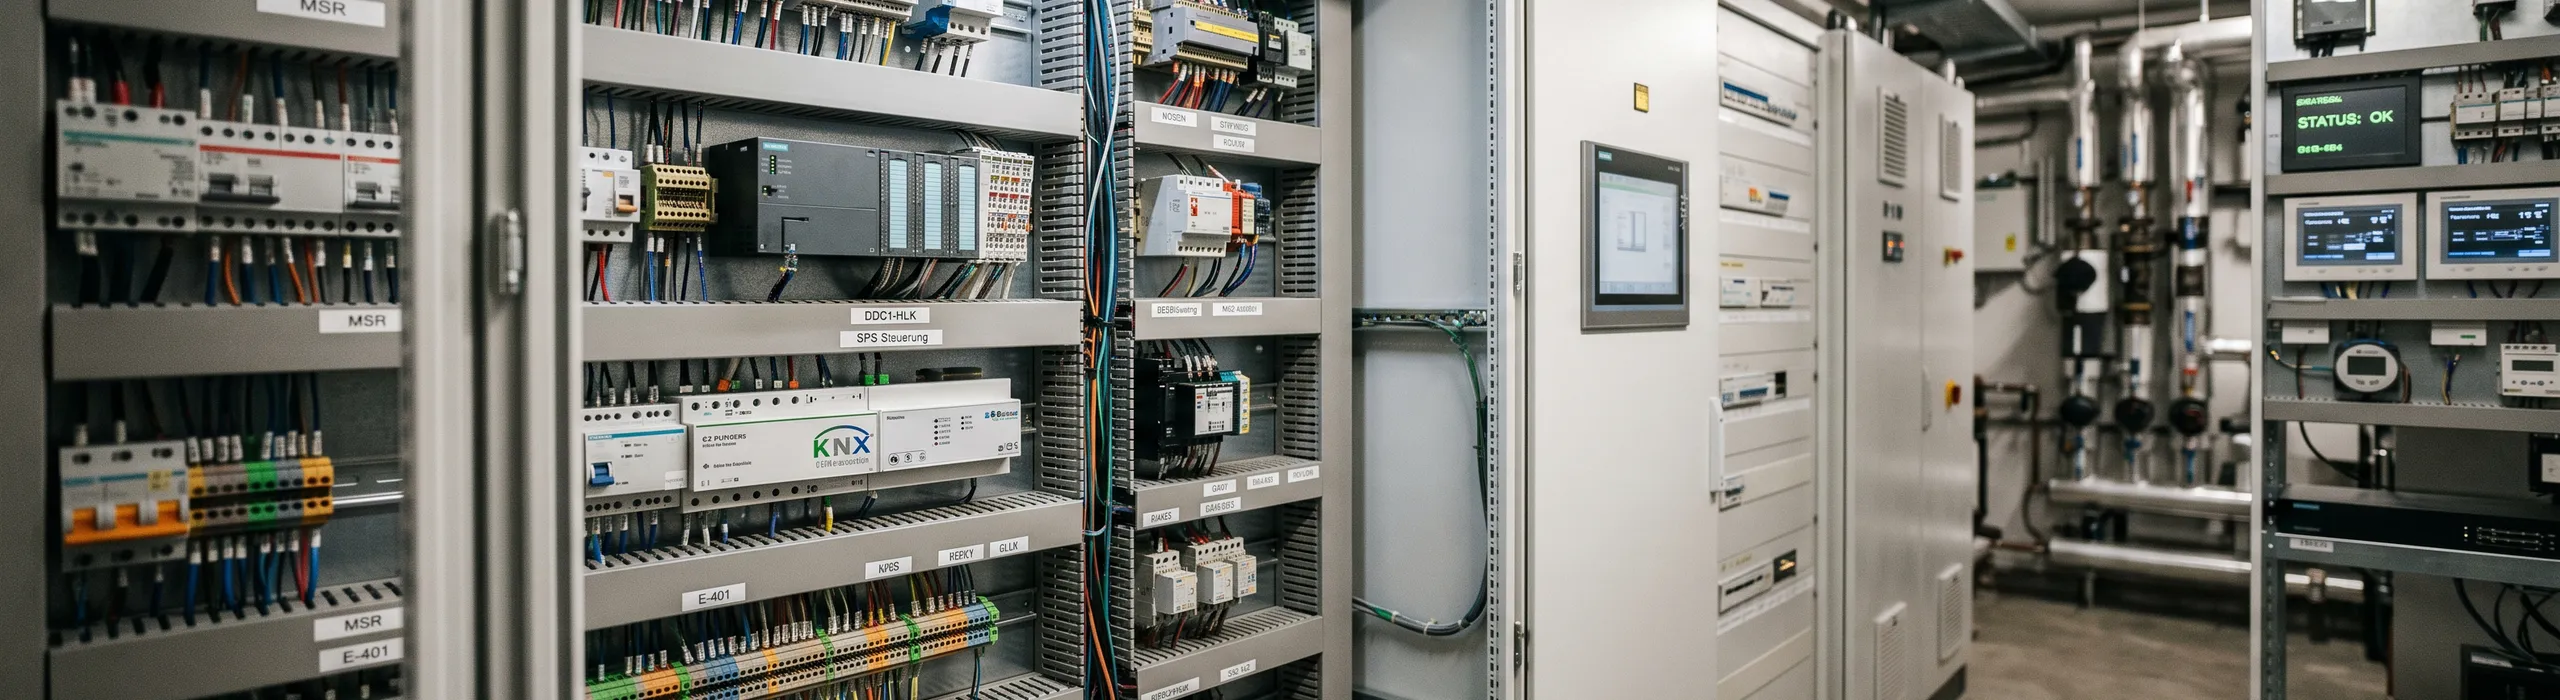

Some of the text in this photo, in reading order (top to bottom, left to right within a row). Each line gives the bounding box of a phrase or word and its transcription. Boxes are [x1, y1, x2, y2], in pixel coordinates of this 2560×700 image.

[300, 0, 346, 16] MSR
[2297, 109, 2394, 129] STATUS: OK
[348, 314, 387, 327] MSR
[864, 310, 917, 321] DDC1-HLK
[856, 331, 929, 345] SPS Steuerung
[813, 435, 871, 459] KNX
[698, 589, 730, 605] E-401
[344, 615, 382, 632] MSR
[343, 645, 388, 664] E-401
